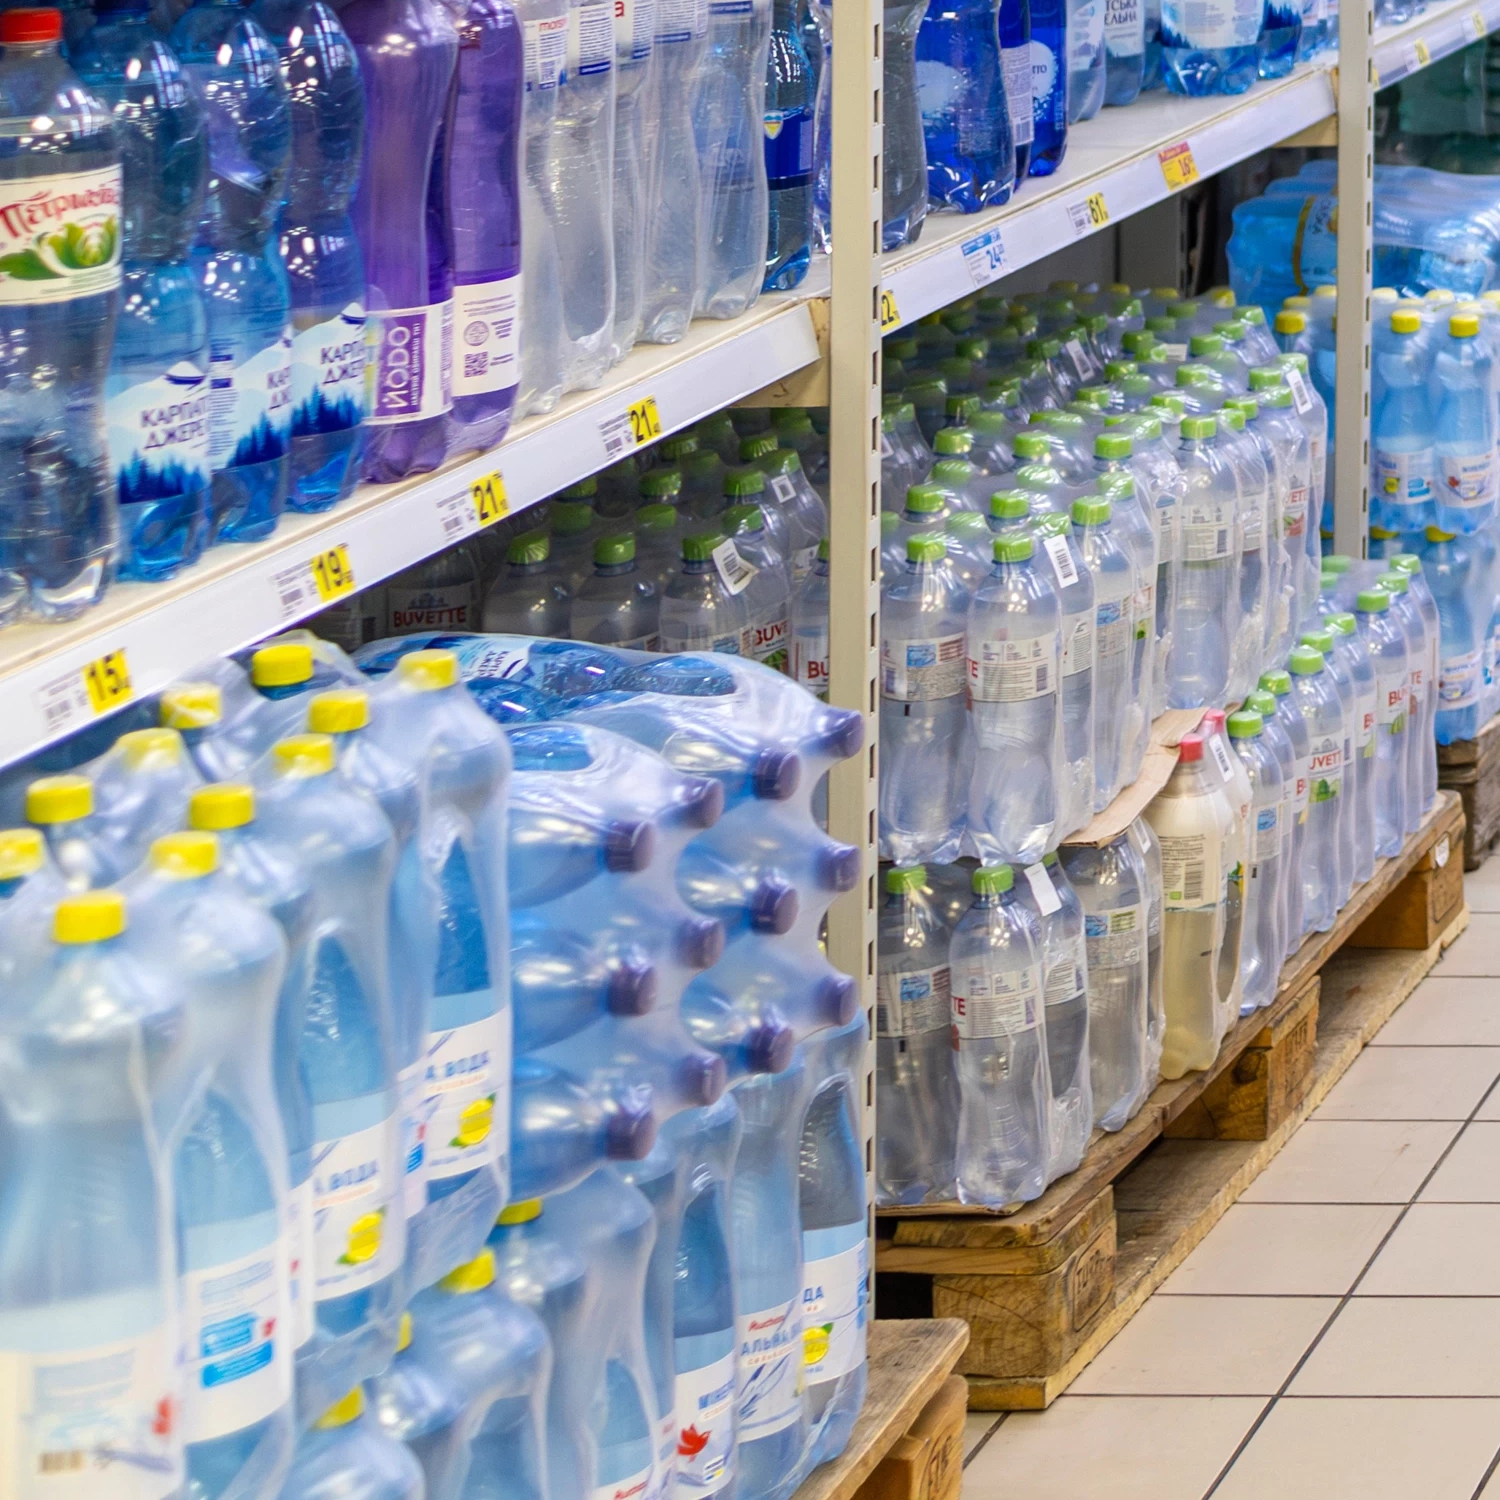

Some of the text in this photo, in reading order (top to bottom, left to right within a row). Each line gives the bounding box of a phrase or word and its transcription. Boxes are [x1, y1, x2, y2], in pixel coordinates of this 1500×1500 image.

[386, 325, 412, 408] ЙОДО
[629, 405, 653, 443] 21
[473, 479, 500, 521] 21
[315, 550, 344, 593] 19
[393, 609, 466, 628] BUVETTE
[87, 654, 120, 702] 15
